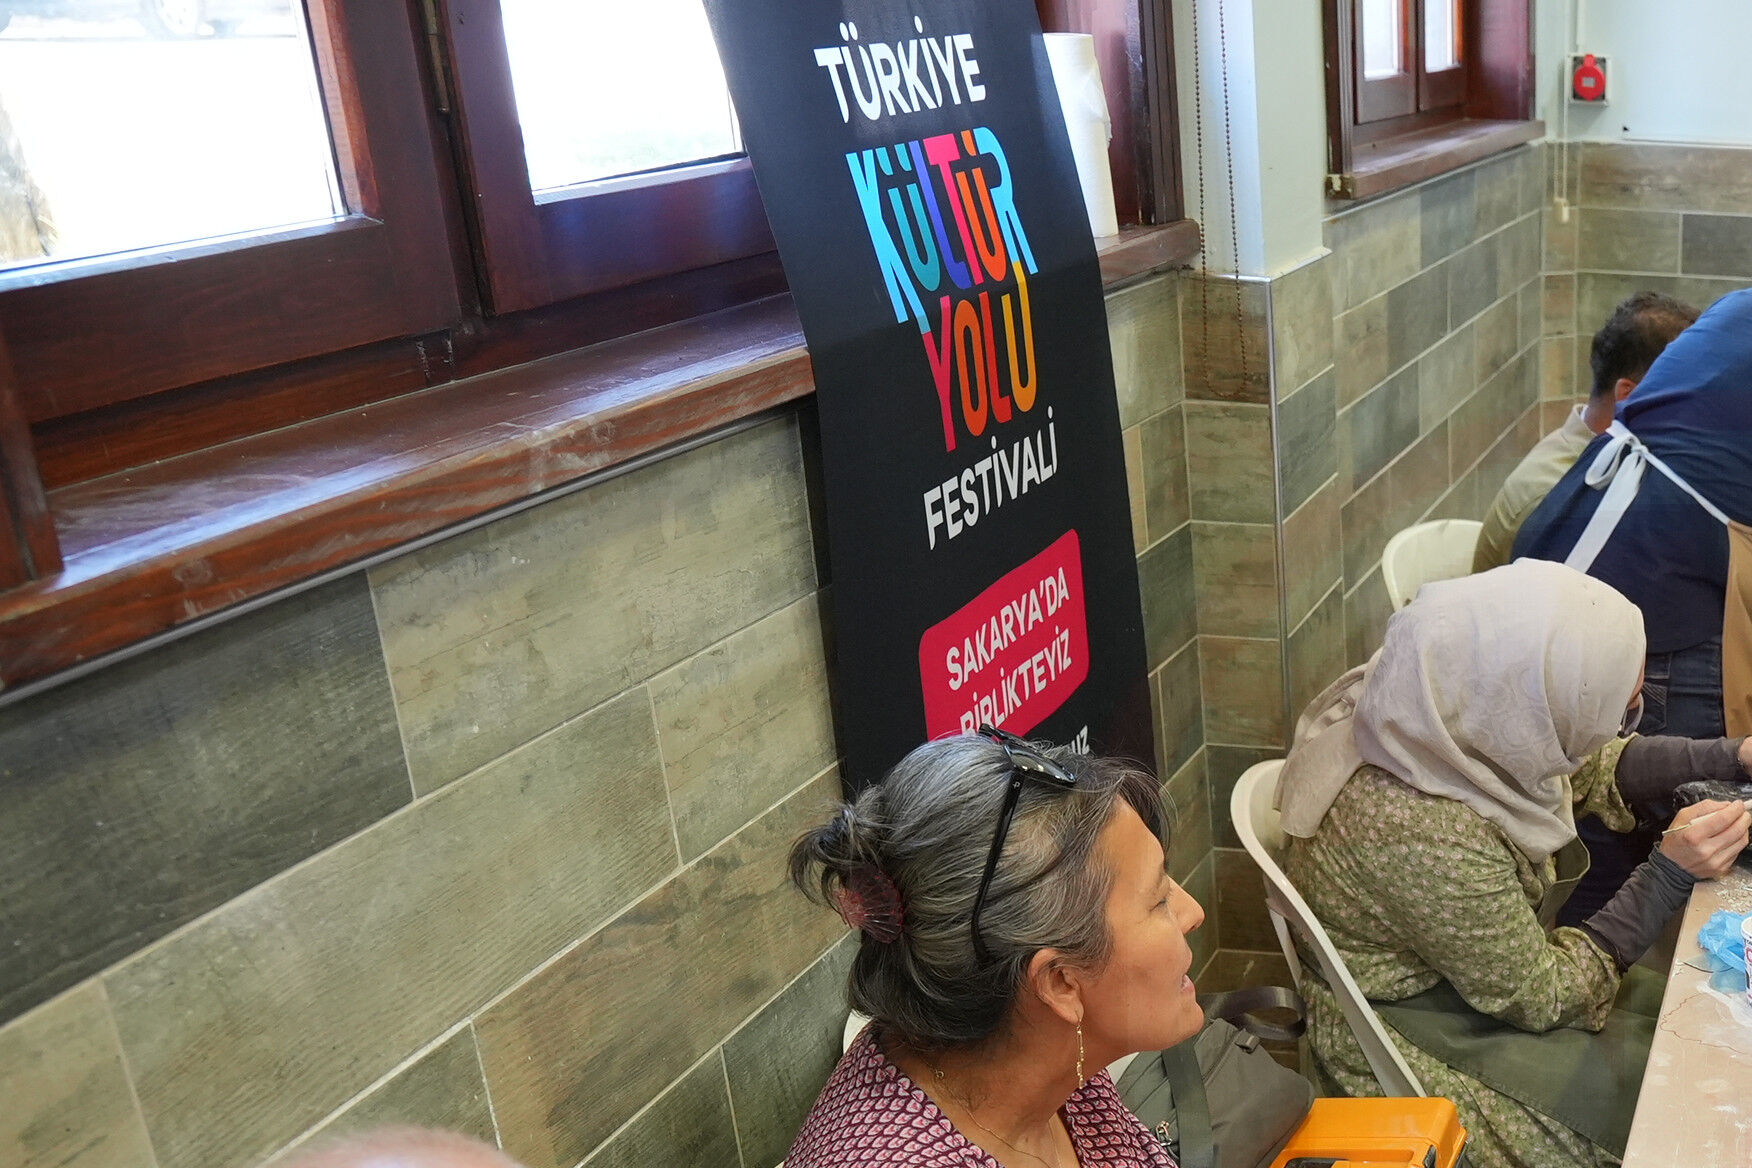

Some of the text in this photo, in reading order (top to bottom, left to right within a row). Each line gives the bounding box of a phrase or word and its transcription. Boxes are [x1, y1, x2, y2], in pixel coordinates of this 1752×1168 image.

[815, 16, 986, 123] TÜRKİYE
[846, 126, 1039, 334] KÜLTÜR
[922, 261, 1037, 452] YOLU
[923, 405, 1058, 551] FESTİVALİ
[945, 566, 1070, 691] SAKARYA'DA
[959, 624, 1073, 738] BİRLİKTEYİZ
